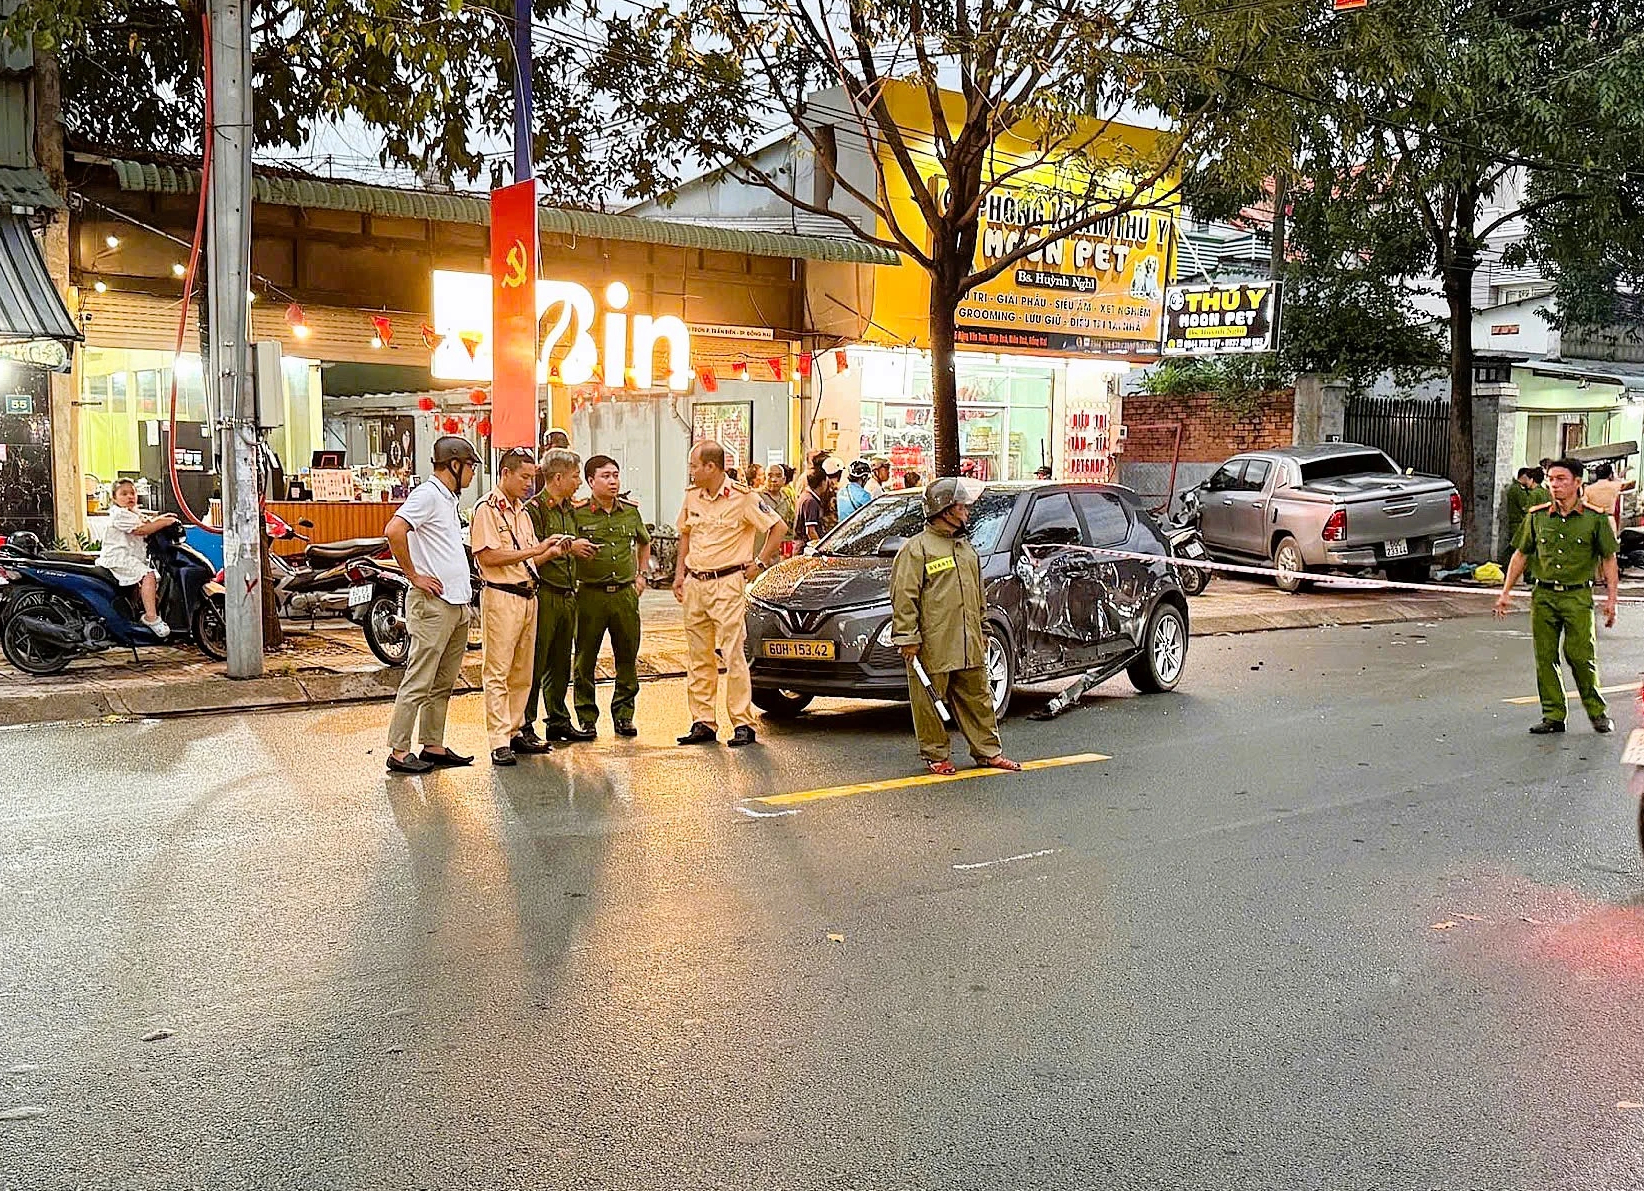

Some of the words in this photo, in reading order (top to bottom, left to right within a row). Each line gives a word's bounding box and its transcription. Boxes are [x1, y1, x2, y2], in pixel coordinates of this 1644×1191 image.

[1157, 217, 1170, 245] Y
[1075, 239, 1131, 273] PET
[1035, 272, 1070, 288] Huỳnh
[1185, 288, 1242, 313] THÚ
[1246, 289, 1268, 310] Y
[958, 307, 1016, 322] GROOMING
[1178, 312, 1221, 329] MOON
[1224, 310, 1258, 326] PET
[11, 399, 28, 409] 55
[1071, 458, 1105, 473] PETSHOP
